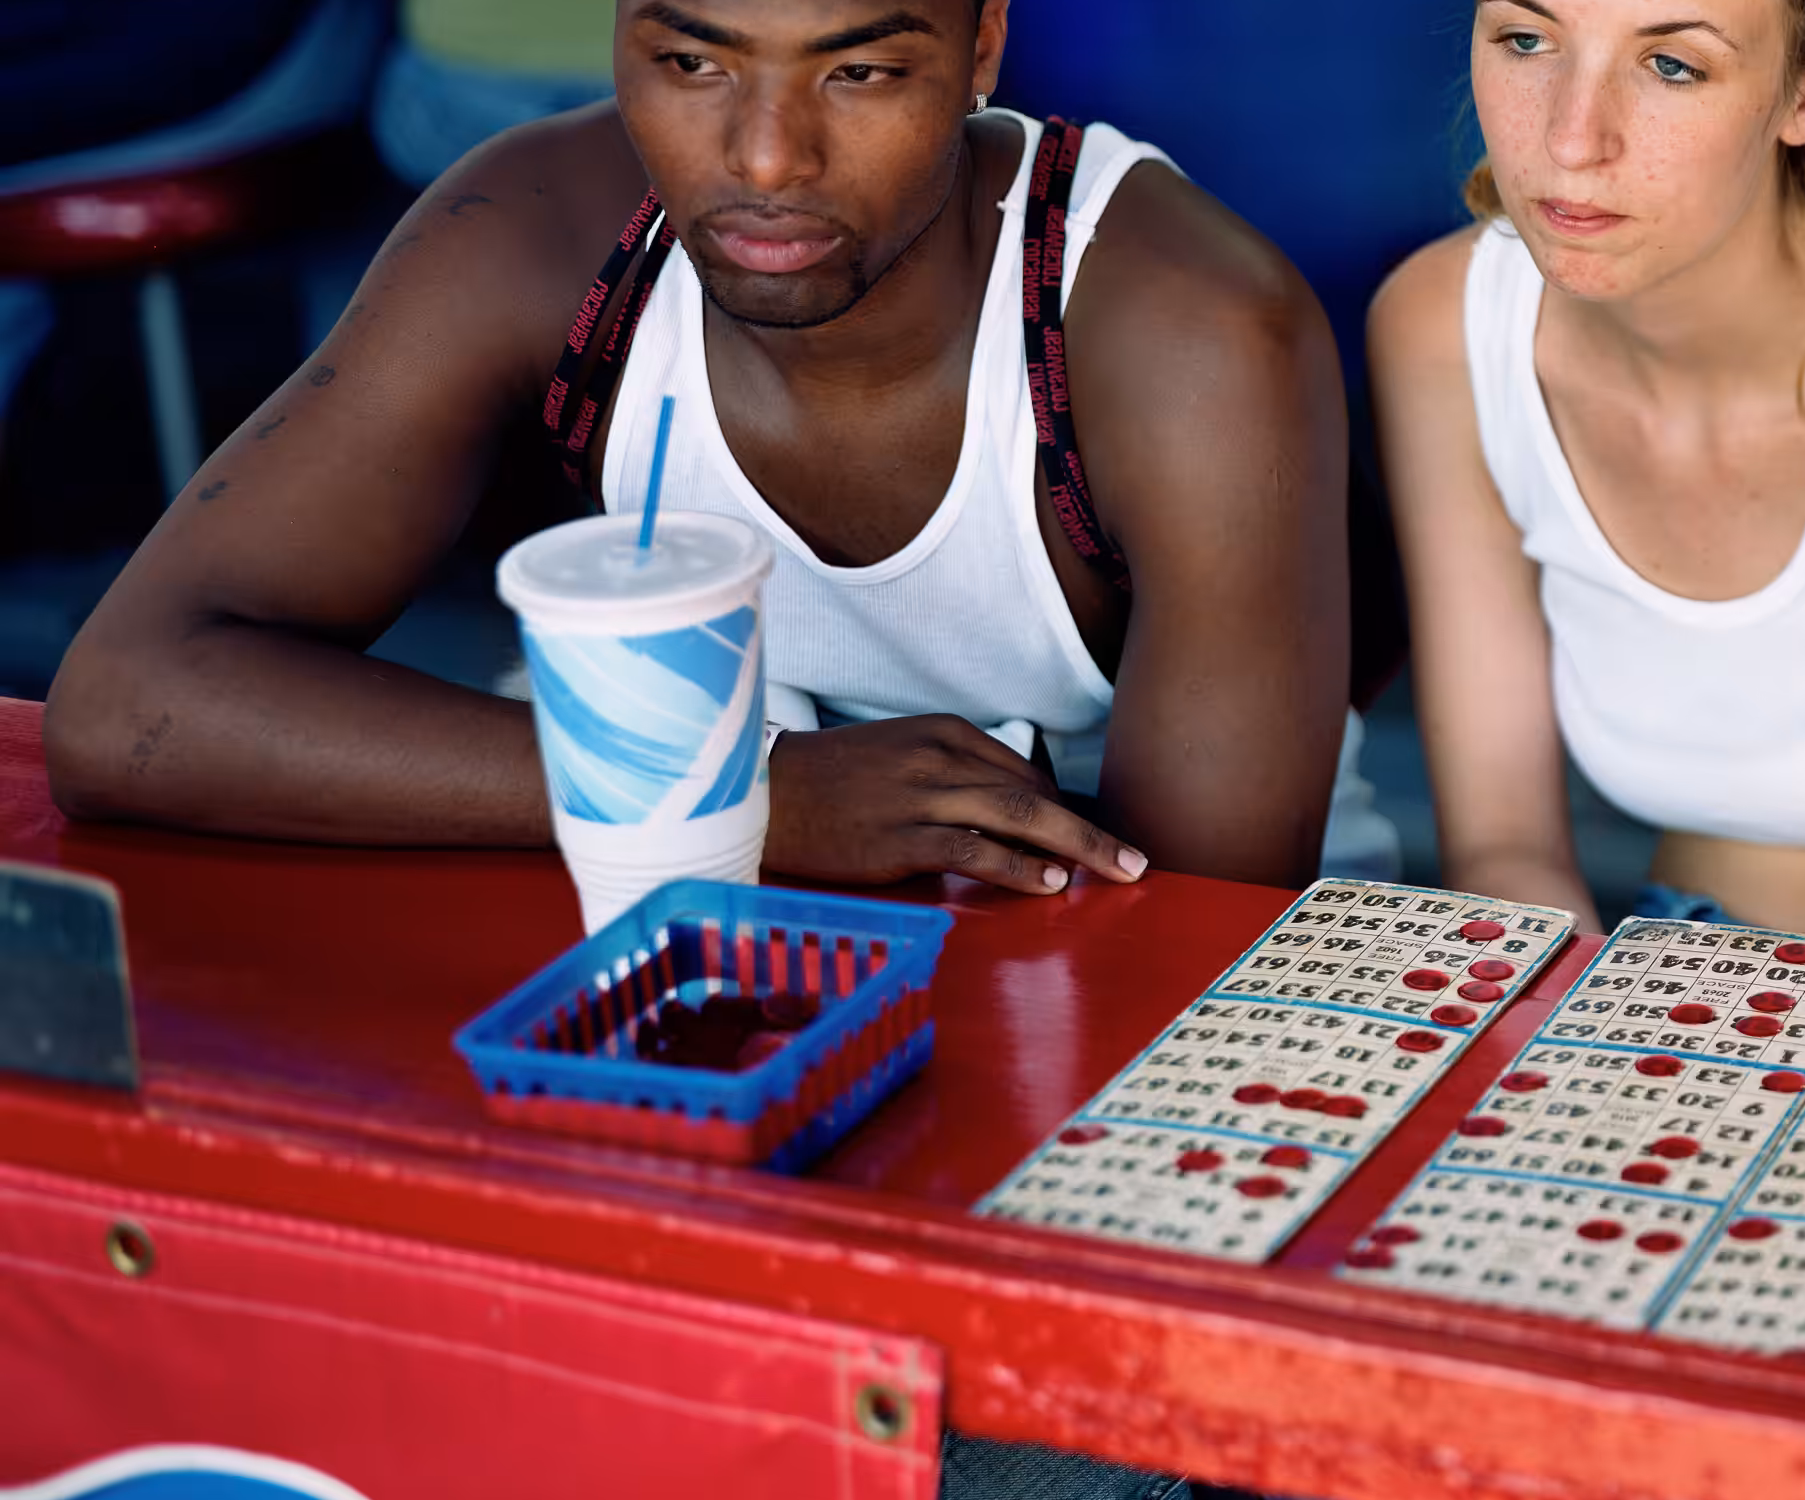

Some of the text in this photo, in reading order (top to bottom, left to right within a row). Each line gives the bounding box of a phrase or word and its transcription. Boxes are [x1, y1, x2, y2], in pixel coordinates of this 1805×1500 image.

[1024, 238, 1042, 323] rocawear
[566, 276, 609, 355] rocawear
[1044, 325, 1069, 412] rocawear
[1311, 890, 1358, 903] 68
[1362, 894, 1406, 909] 50
[1419, 899, 1456, 915] 41
[1285, 911, 1337, 925] 64
[1339, 915, 1388, 931] 54
[1519, 917, 1555, 933] 11
[1393, 920, 1439, 937] 36
[1271, 933, 1366, 952] 46 66
[1375, 938, 1425, 949] SPACE
[1502, 940, 1528, 953] 8
[1730, 936, 1771, 952] 33
[1368, 952, 1405, 962] FREE
[1423, 950, 1471, 968] 26
[1610, 950, 1651, 965] 61
[1661, 954, 1703, 970] 54
[1250, 955, 1399, 983] 35 58 61
[1711, 959, 1759, 977] 40
[1588, 974, 1689, 995] 46 64
[1696, 979, 1748, 991] SPACE
[1222, 979, 1431, 1016] 22 33 53 67
[1692, 995, 1731, 1005] FREE
[1568, 999, 1616, 1014] 69
[1624, 1004, 1670, 1019] 58
[1551, 1022, 1802, 1065] 1 26 38 59 62
